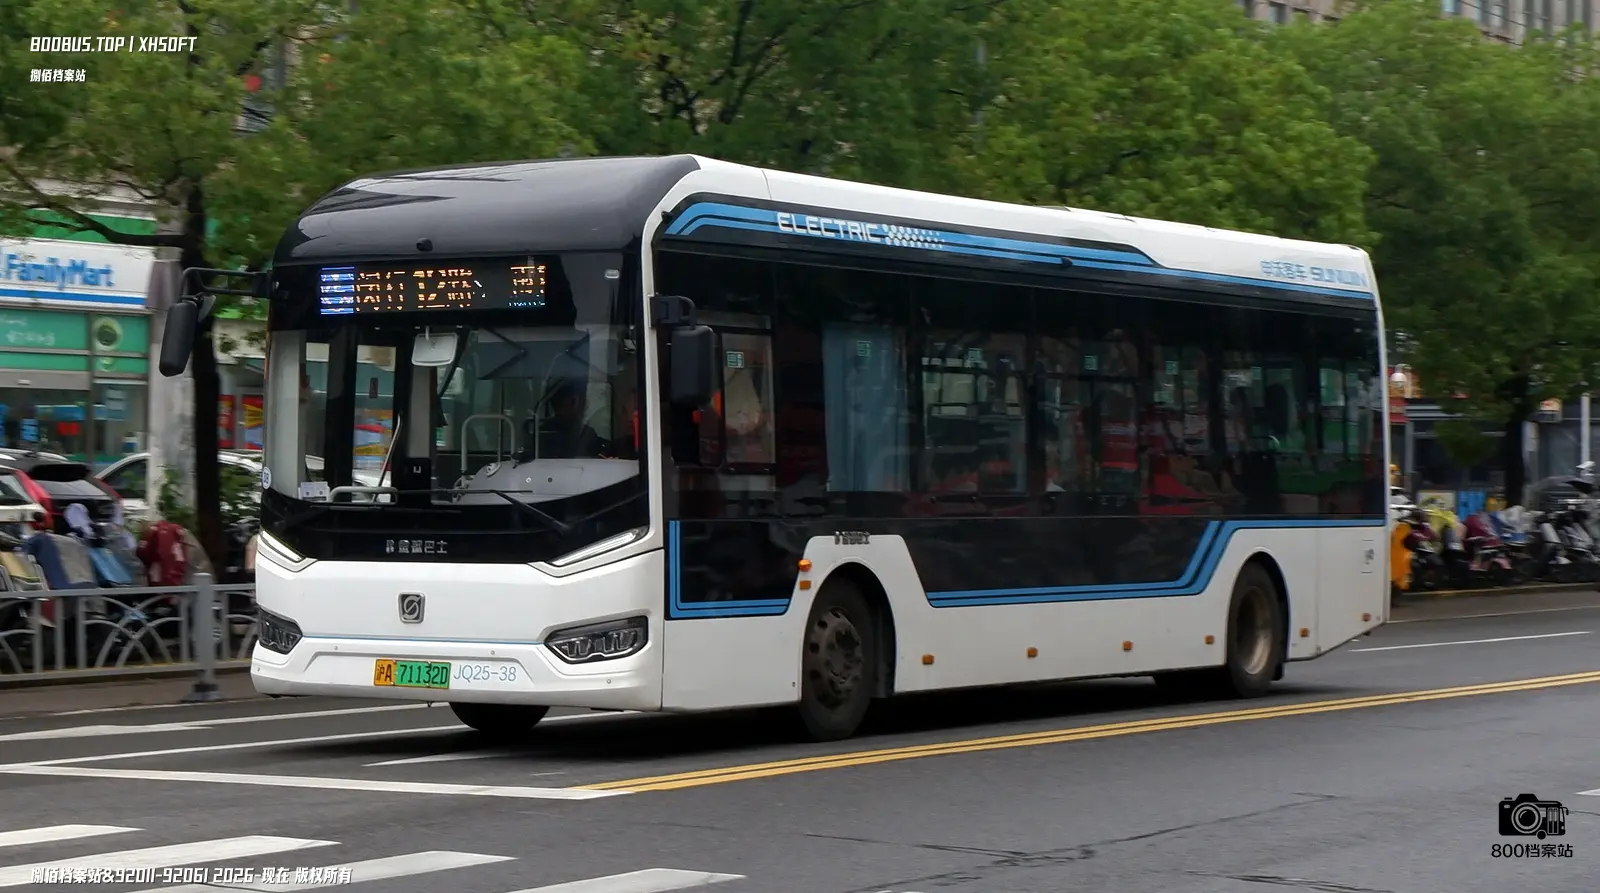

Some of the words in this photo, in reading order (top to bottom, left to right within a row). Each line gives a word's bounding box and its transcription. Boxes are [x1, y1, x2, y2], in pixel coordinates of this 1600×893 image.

[776, 212, 882, 242] ELECTRIC
[7, 253, 115, 290] FamilyMart
[400, 663, 449, 684] 71132D
[453, 664, 517, 683] JQ25-38
